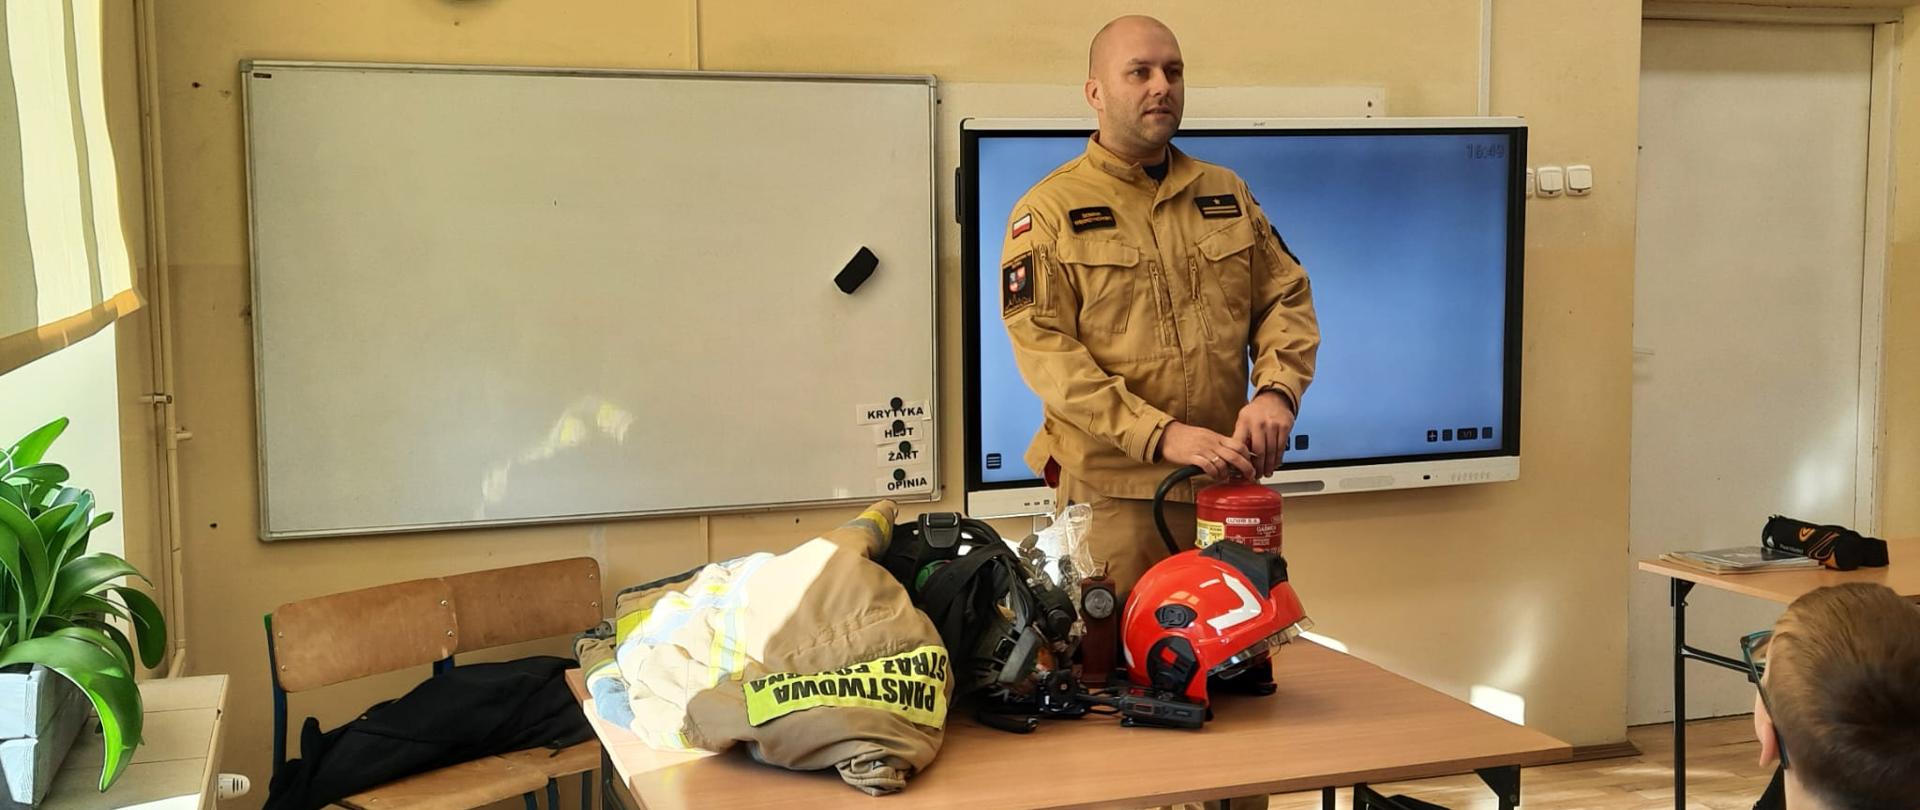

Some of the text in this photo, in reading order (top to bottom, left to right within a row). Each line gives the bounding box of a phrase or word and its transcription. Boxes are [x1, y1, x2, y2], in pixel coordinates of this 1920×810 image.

[867, 407, 924, 419] KRYTYKA
[888, 450, 919, 461] ŻART
[887, 477, 928, 491] OPINIA
[772, 677, 936, 712] PAŃSTWOWA
